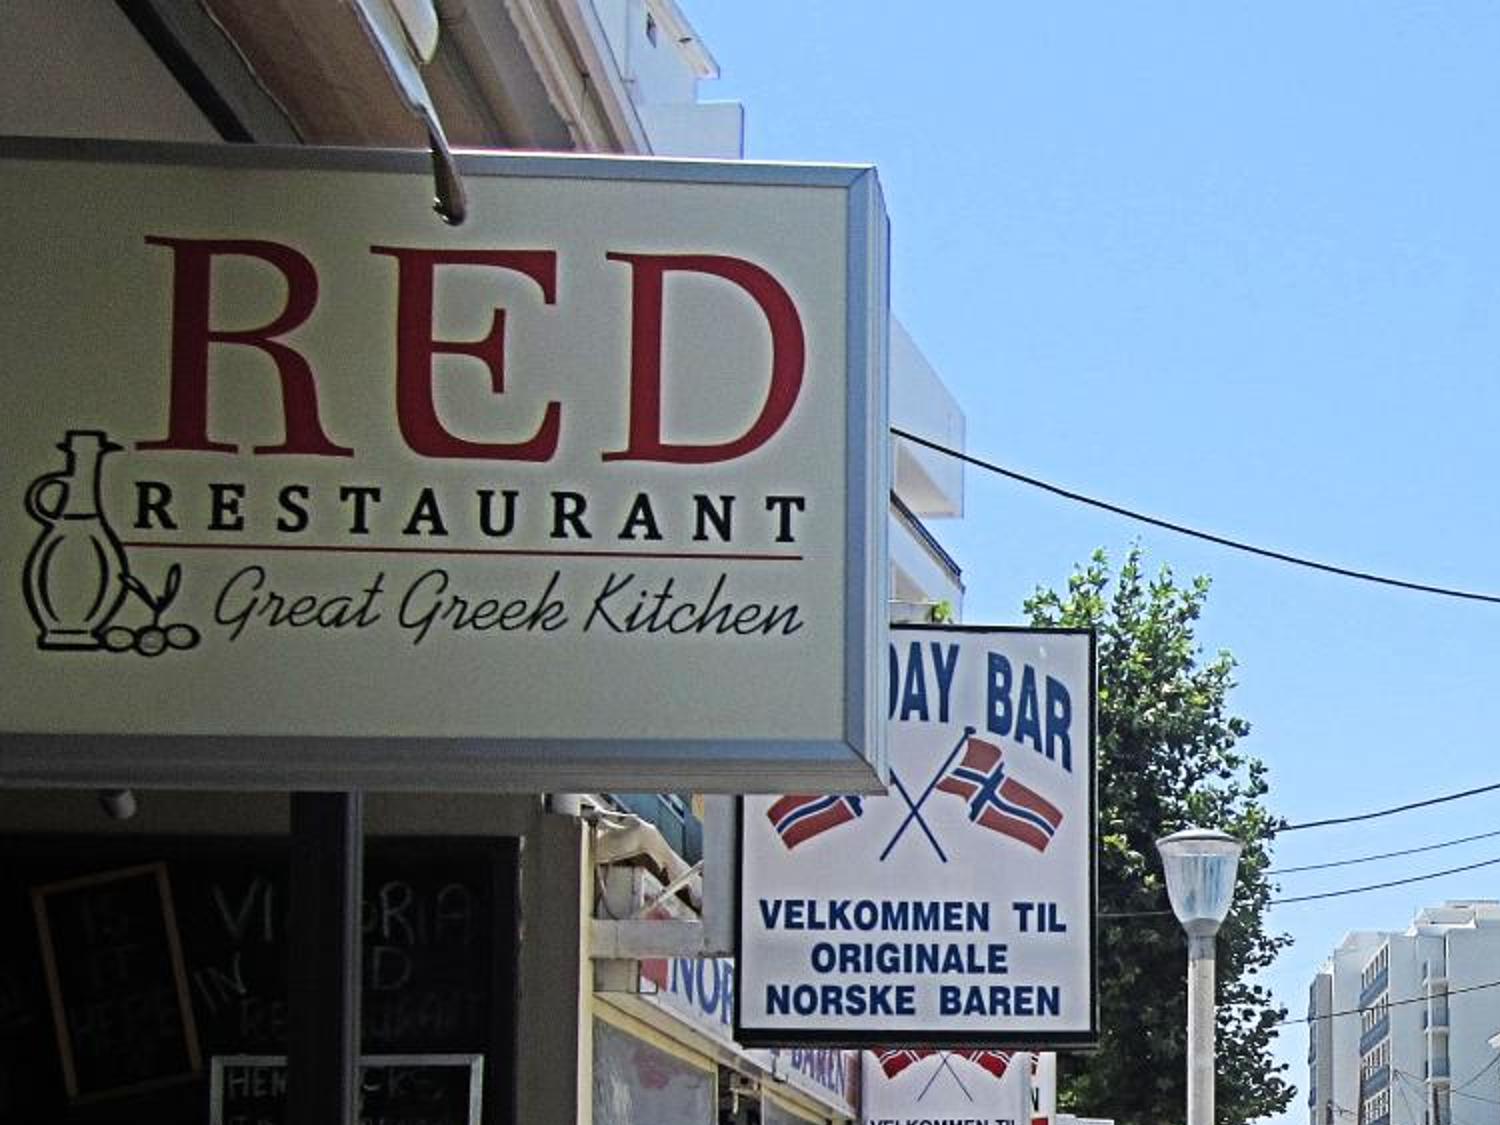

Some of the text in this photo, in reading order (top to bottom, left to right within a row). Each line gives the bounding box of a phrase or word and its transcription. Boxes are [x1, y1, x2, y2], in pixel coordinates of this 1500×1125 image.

[135, 235, 807, 465] RED
[133, 481, 806, 543] RESTAURANT
[213, 565, 804, 645] Great Greek Kitchen
[987, 651, 1073, 774] BAR
[759, 899, 1067, 933] VELKOMMEN TIL
[811, 942, 1009, 975] ORIGINALE
[765, 984, 1061, 1017] NORSKE BAREN
